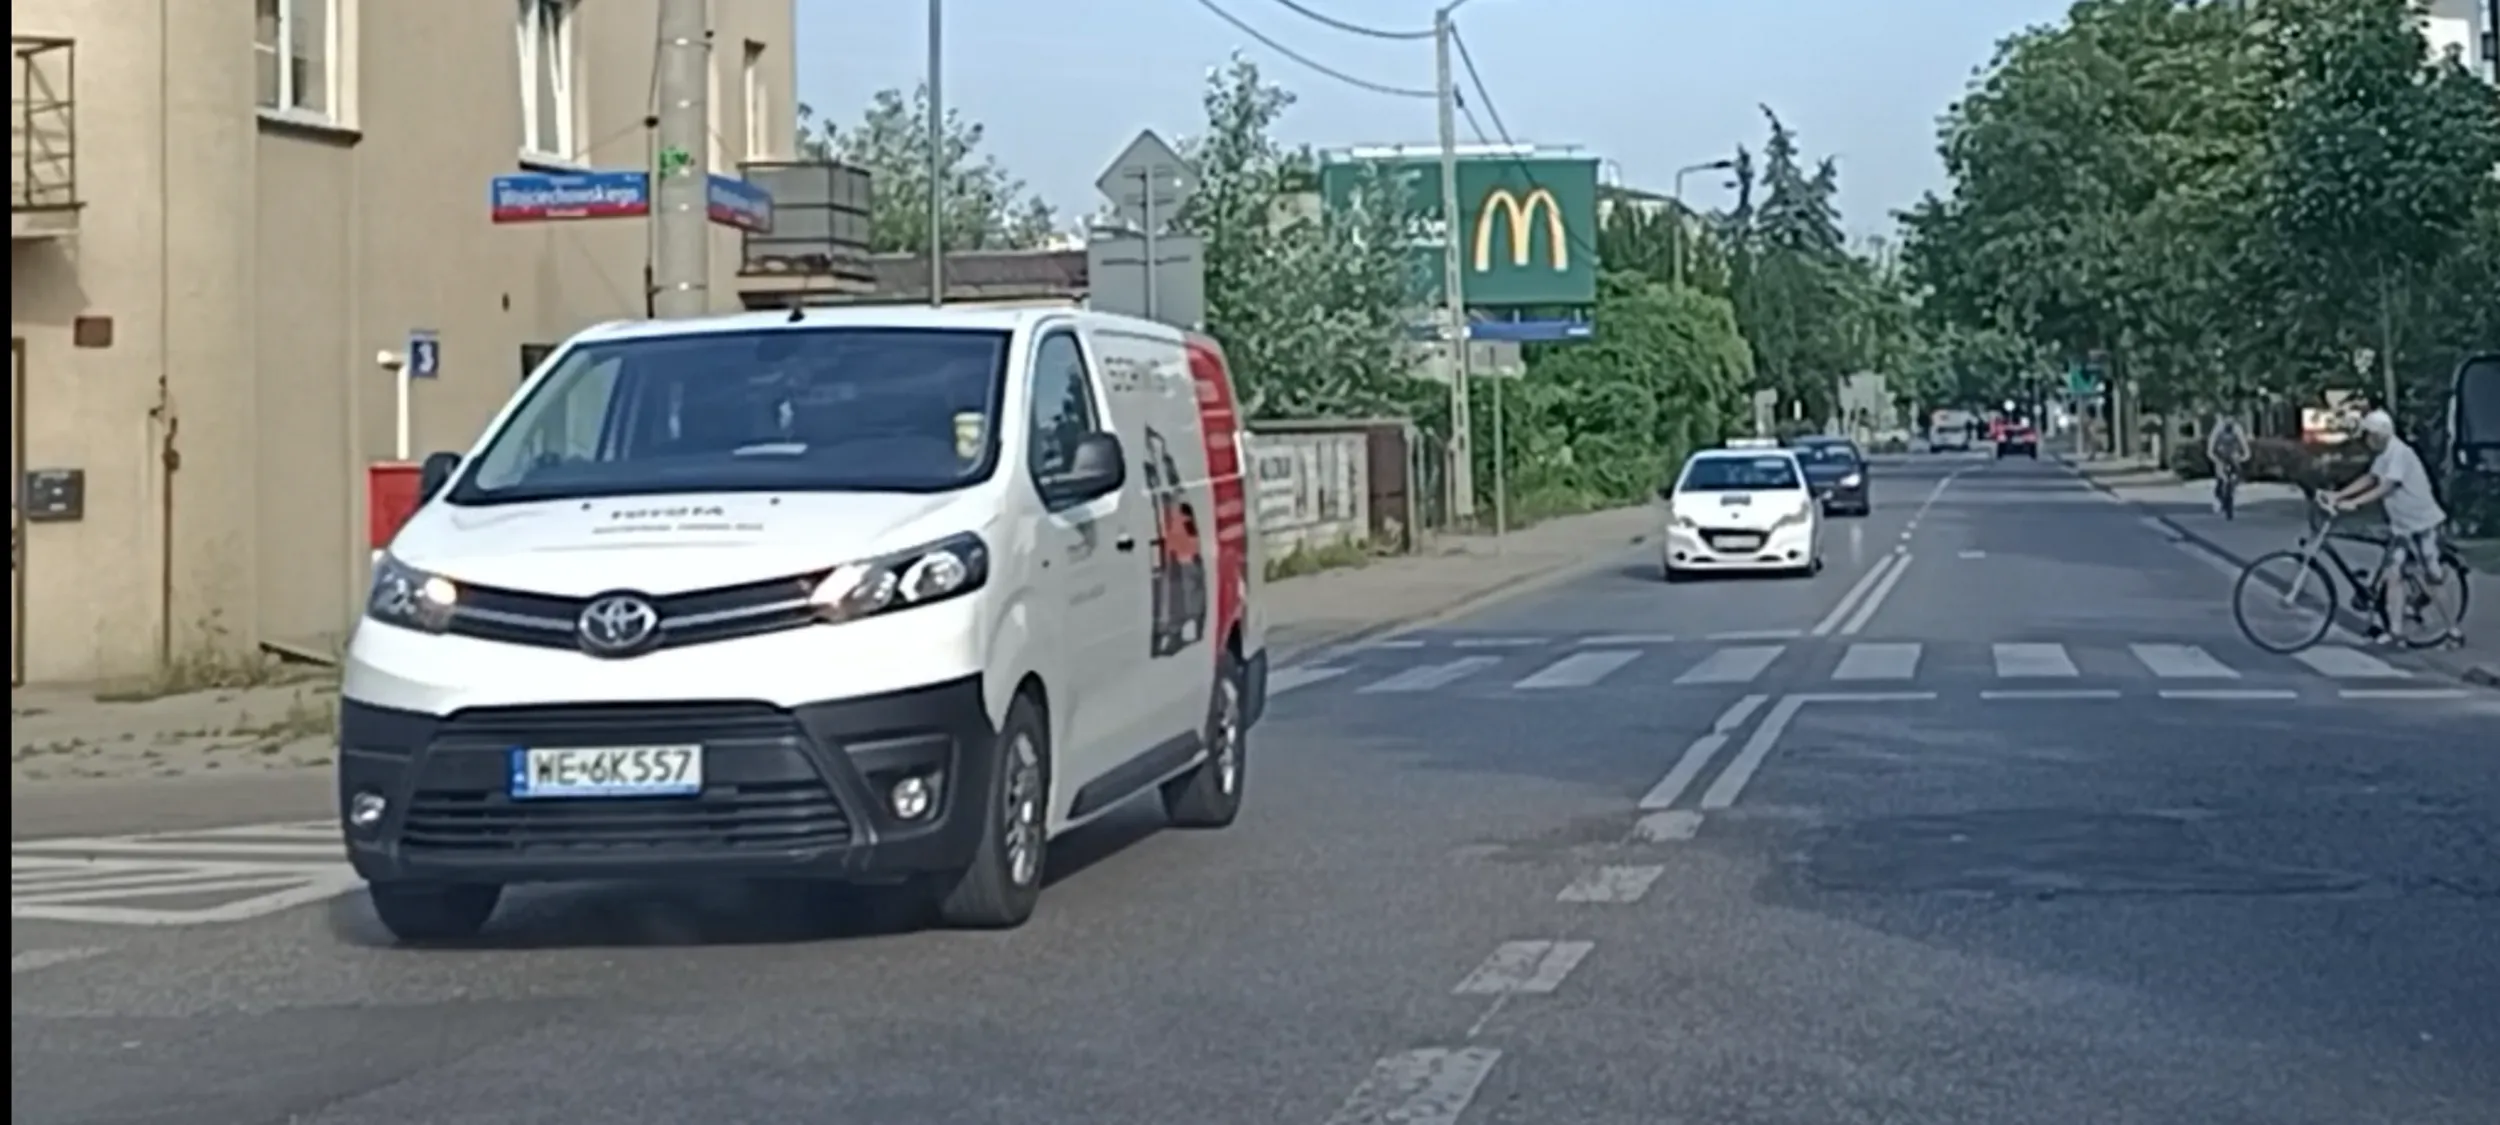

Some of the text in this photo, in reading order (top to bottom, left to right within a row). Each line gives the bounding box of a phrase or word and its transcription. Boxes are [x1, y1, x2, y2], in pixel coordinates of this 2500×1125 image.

[418, 343, 434, 372] 3
[535, 750, 692, 785] WE 6K557
